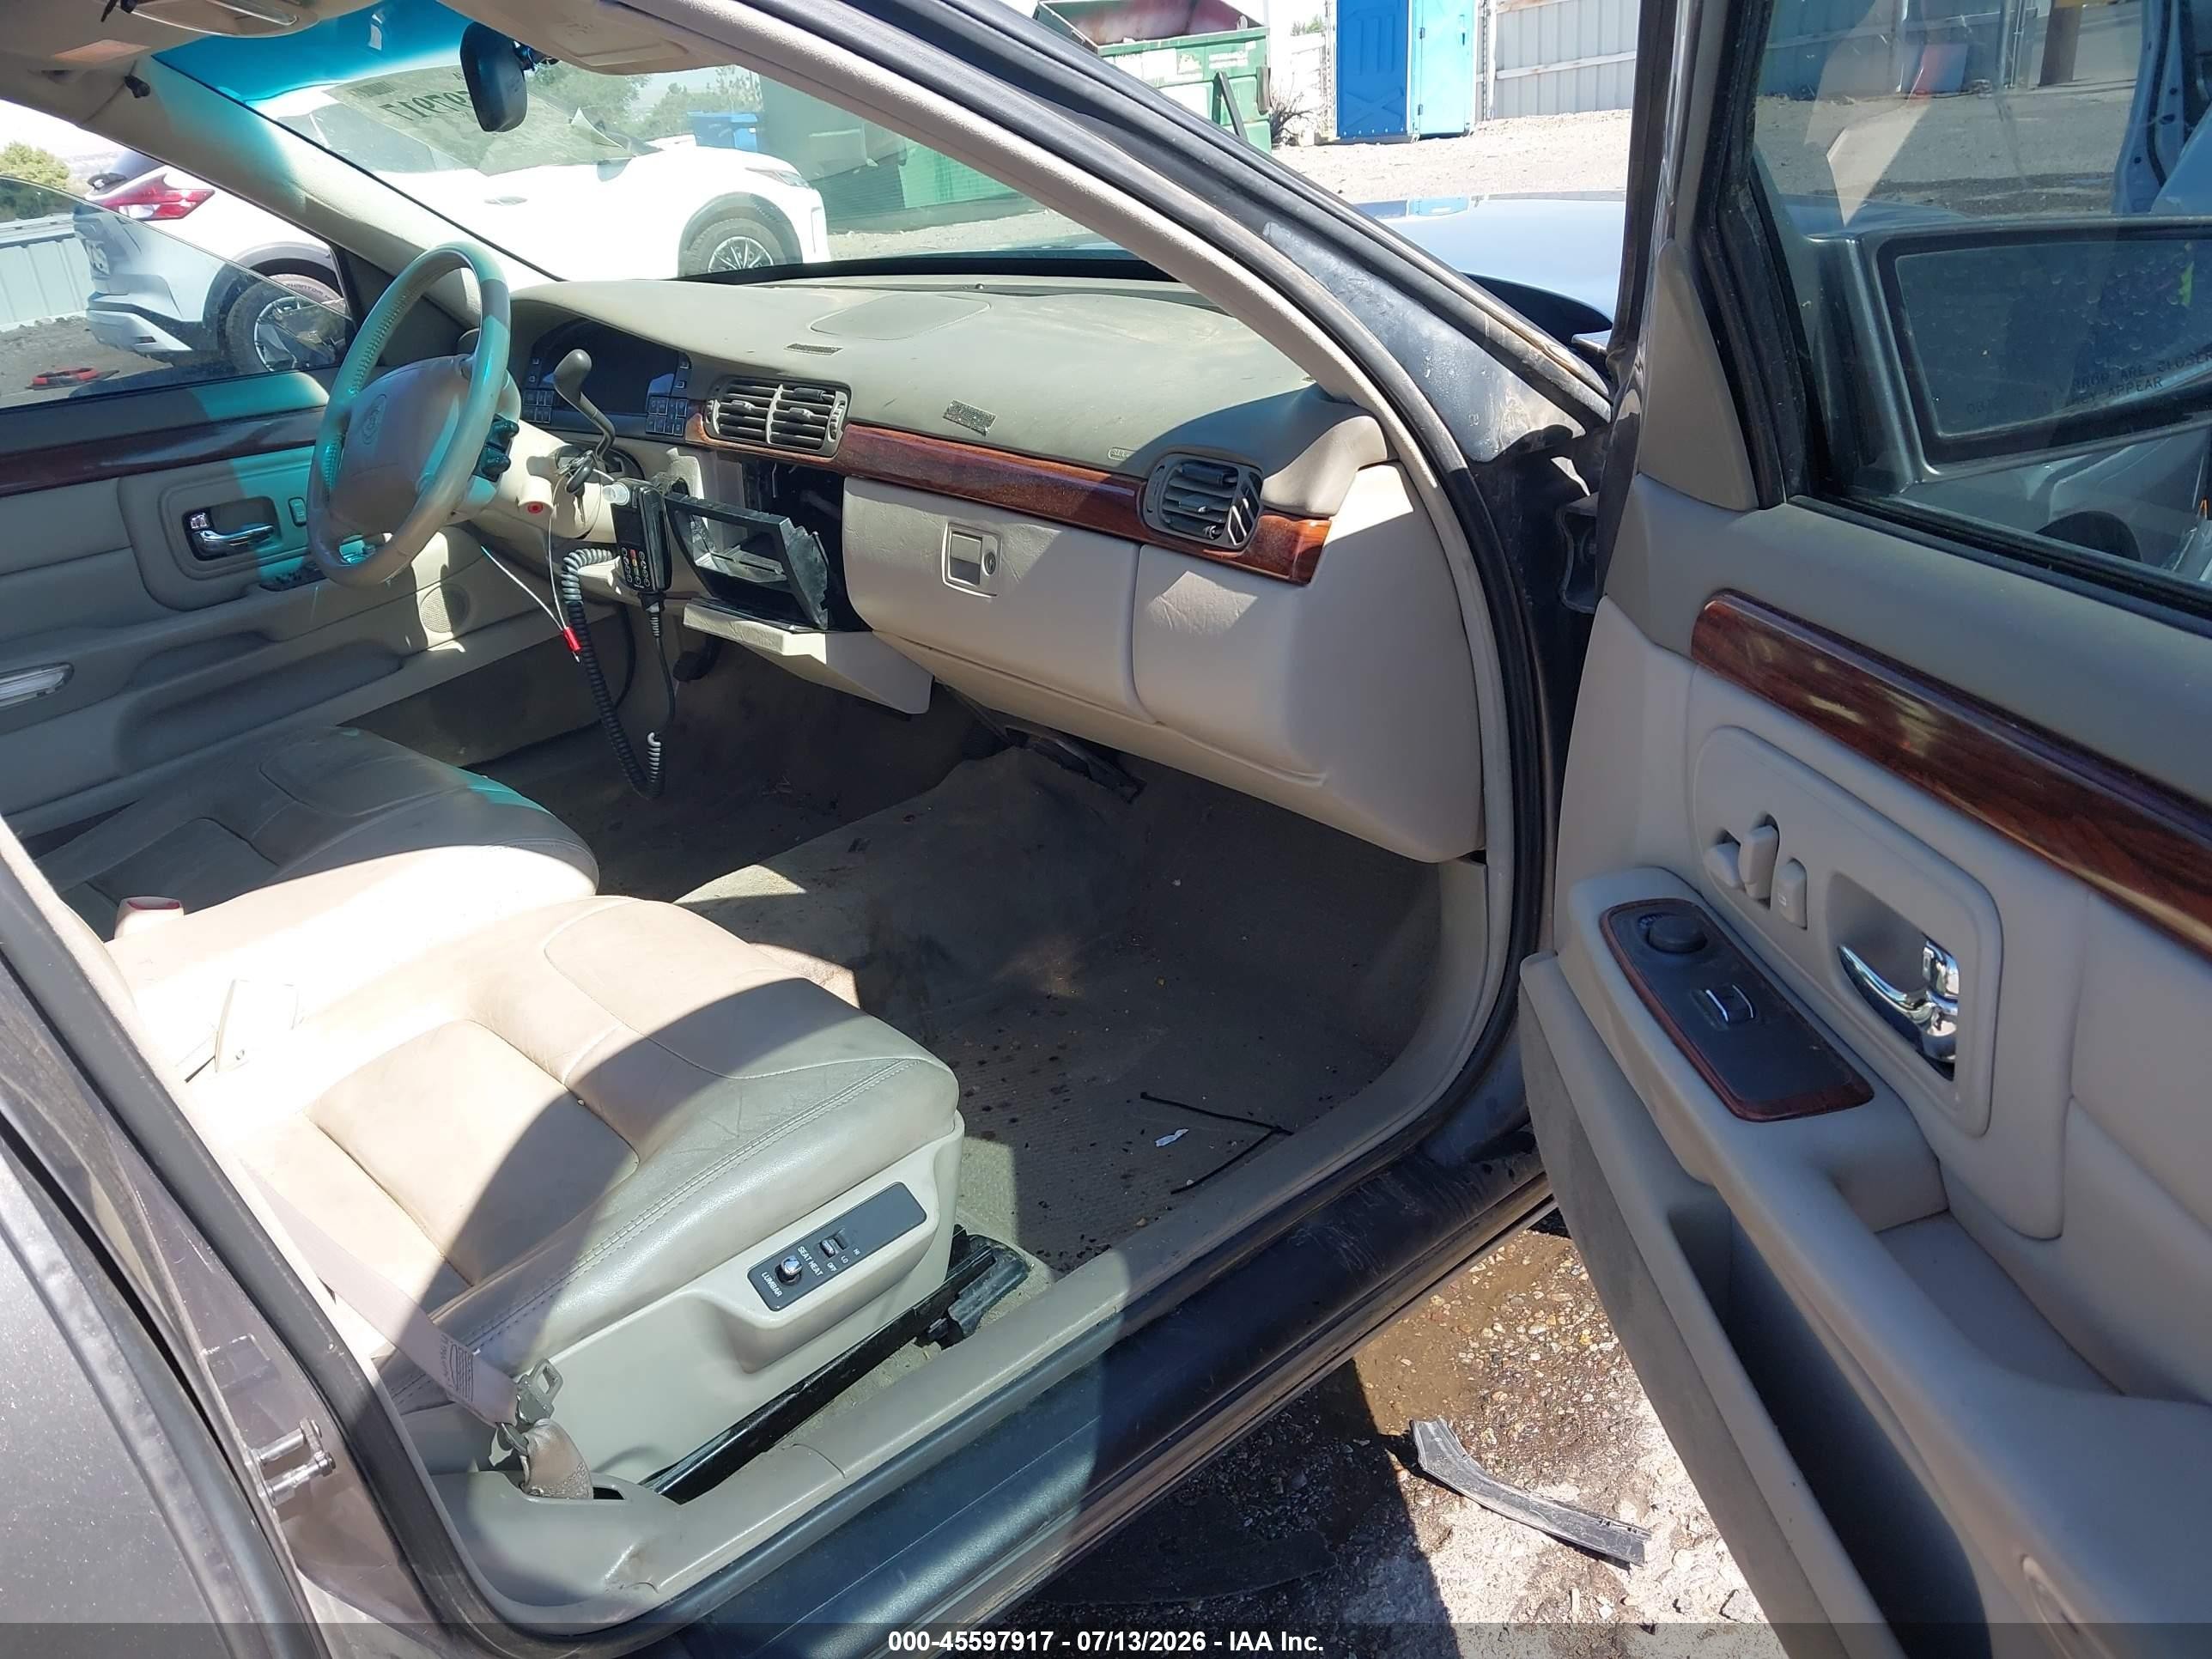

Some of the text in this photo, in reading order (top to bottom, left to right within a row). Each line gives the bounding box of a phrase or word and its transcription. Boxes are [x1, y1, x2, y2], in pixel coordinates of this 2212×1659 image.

[2120, 364, 2145, 380] ARE
[2108, 375, 2164, 398] APPEAR
[797, 1246, 824, 1277] SEAT HEAT
[826, 1261, 837, 1272] OFF
[841, 1255, 849, 1264] LO
[761, 1272, 783, 1297] LUMBAR
